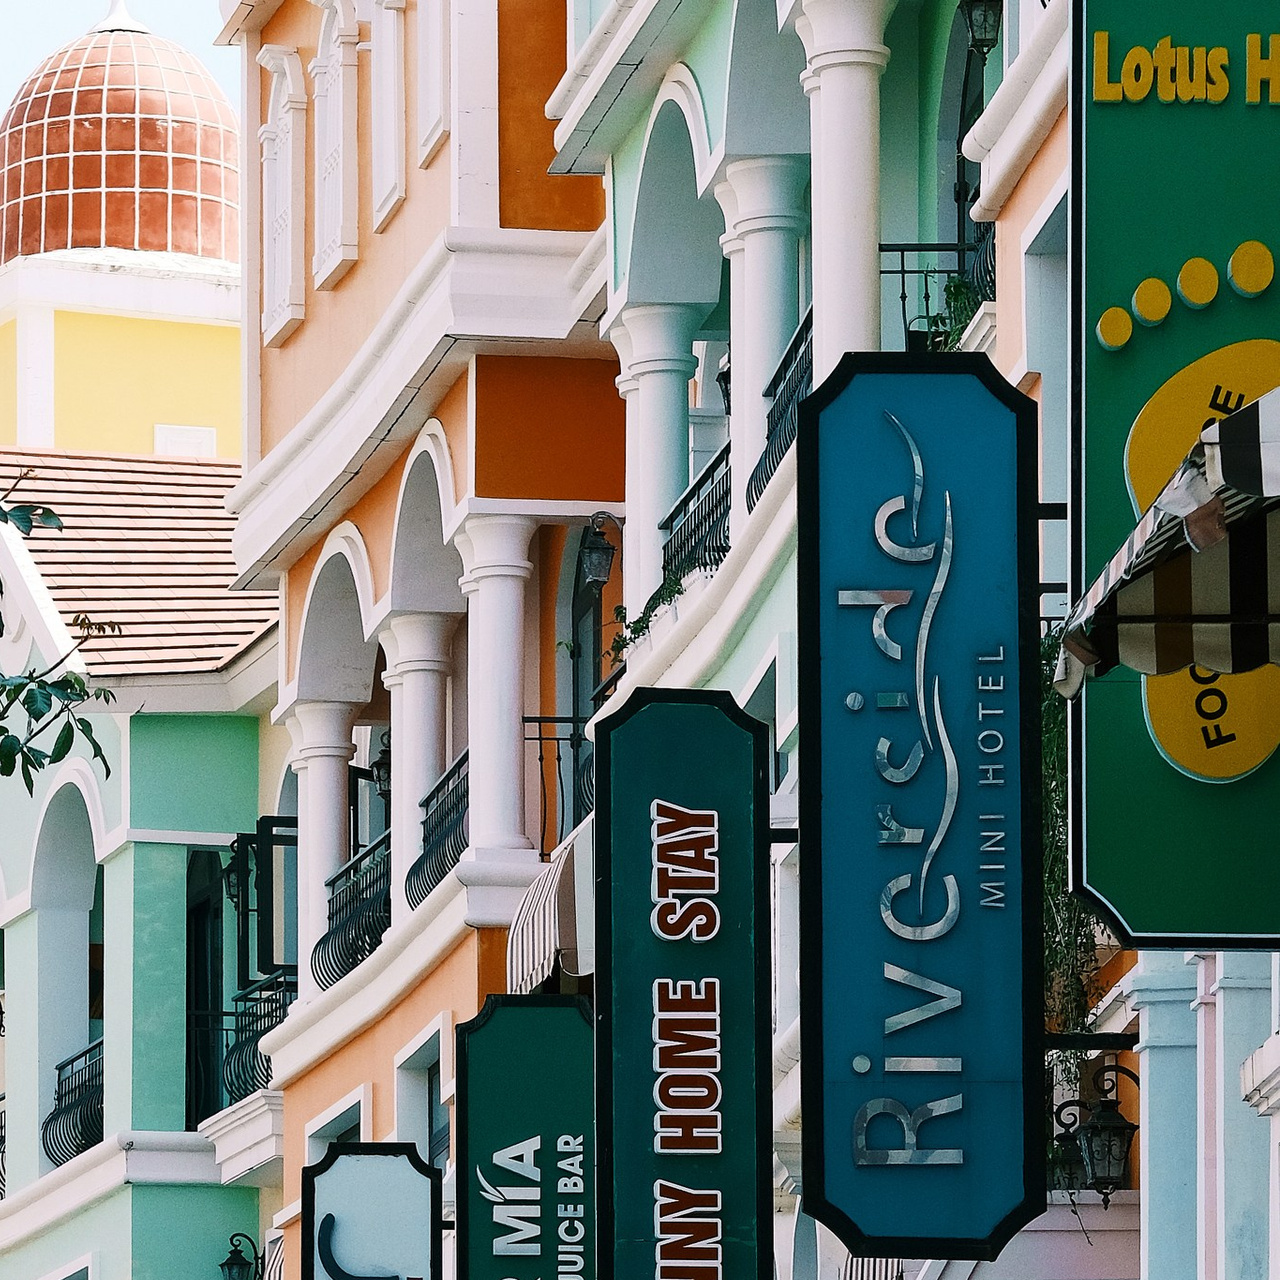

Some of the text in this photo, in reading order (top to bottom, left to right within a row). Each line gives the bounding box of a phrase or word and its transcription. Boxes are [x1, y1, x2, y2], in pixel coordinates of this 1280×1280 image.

[1093, 30, 1230, 105] Lotus
[976, 645, 1005, 908] MINI HOTEL
[651, 799, 720, 942] STAY
[652, 976, 722, 1155] HOME
[556, 1133, 586, 1193] BAR
